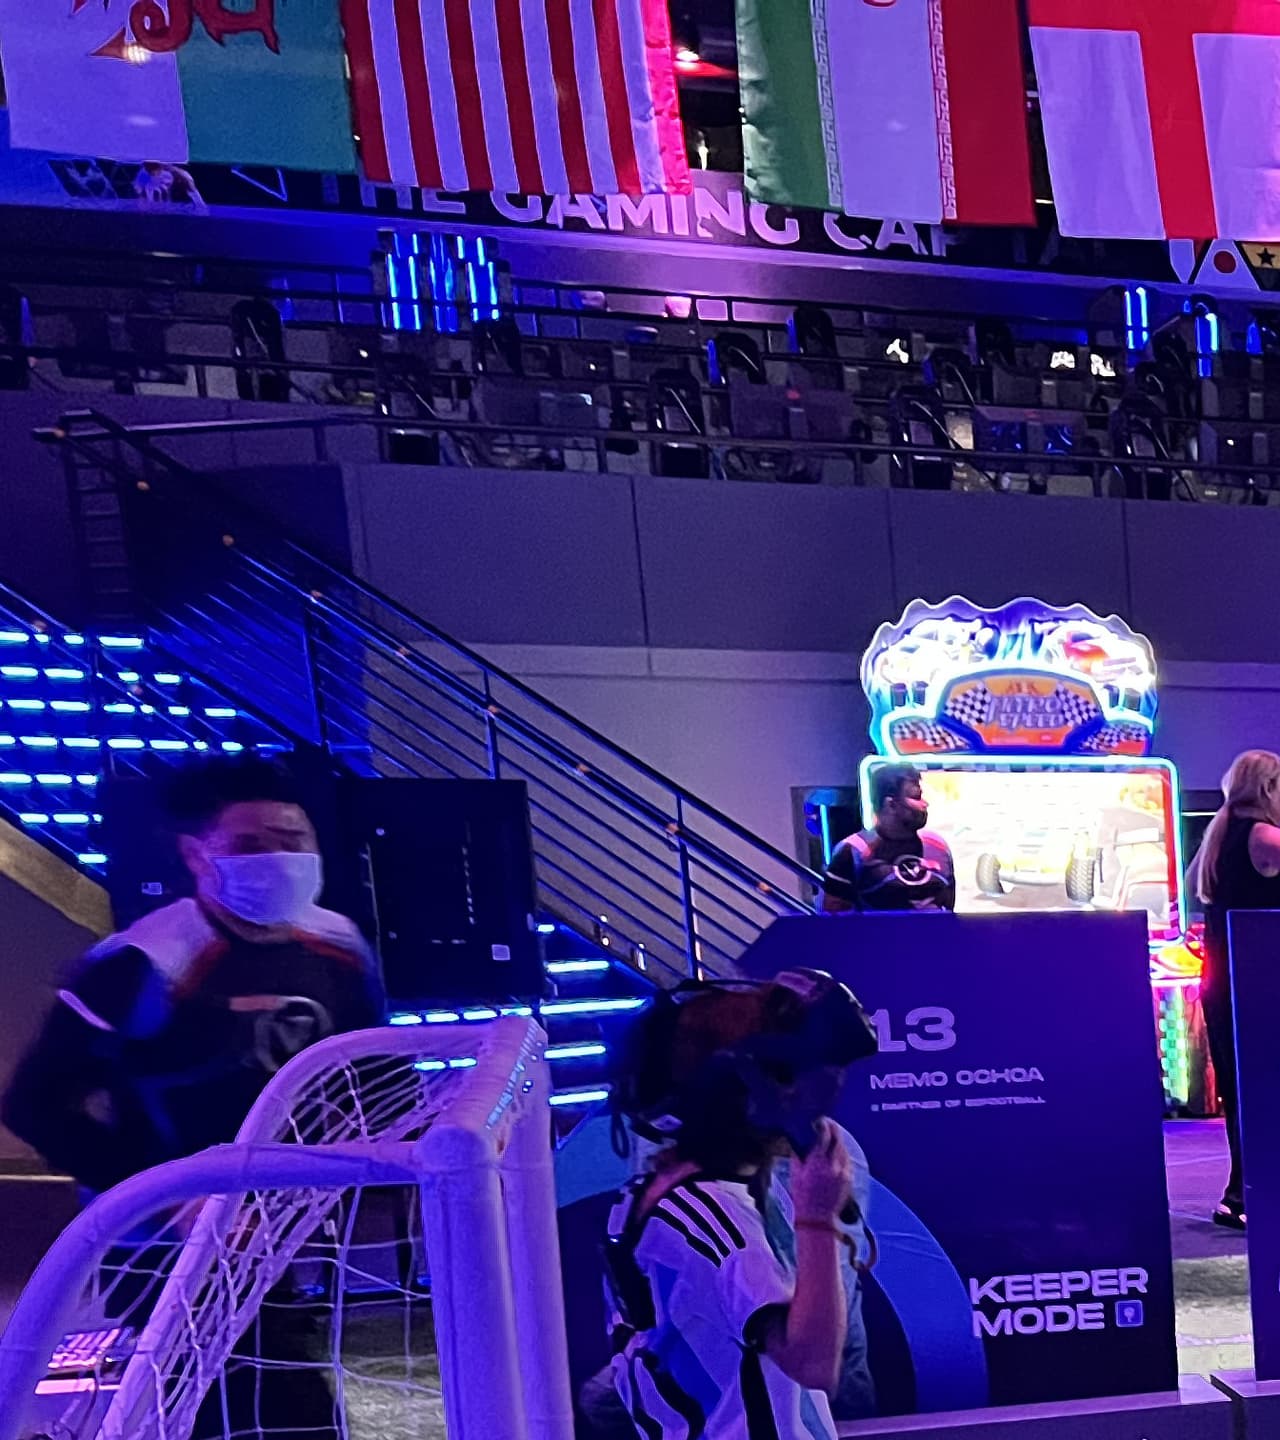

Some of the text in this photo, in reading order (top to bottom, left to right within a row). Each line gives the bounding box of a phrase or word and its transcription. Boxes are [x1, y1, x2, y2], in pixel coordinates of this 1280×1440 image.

[490, 187, 800, 245] GAMING
[869, 1006, 957, 1052] 13
[870, 1067, 1045, 1089] MEMO OCHOA
[969, 1266, 1149, 1305] KEEPER
[972, 1302, 1106, 1338] MODE
